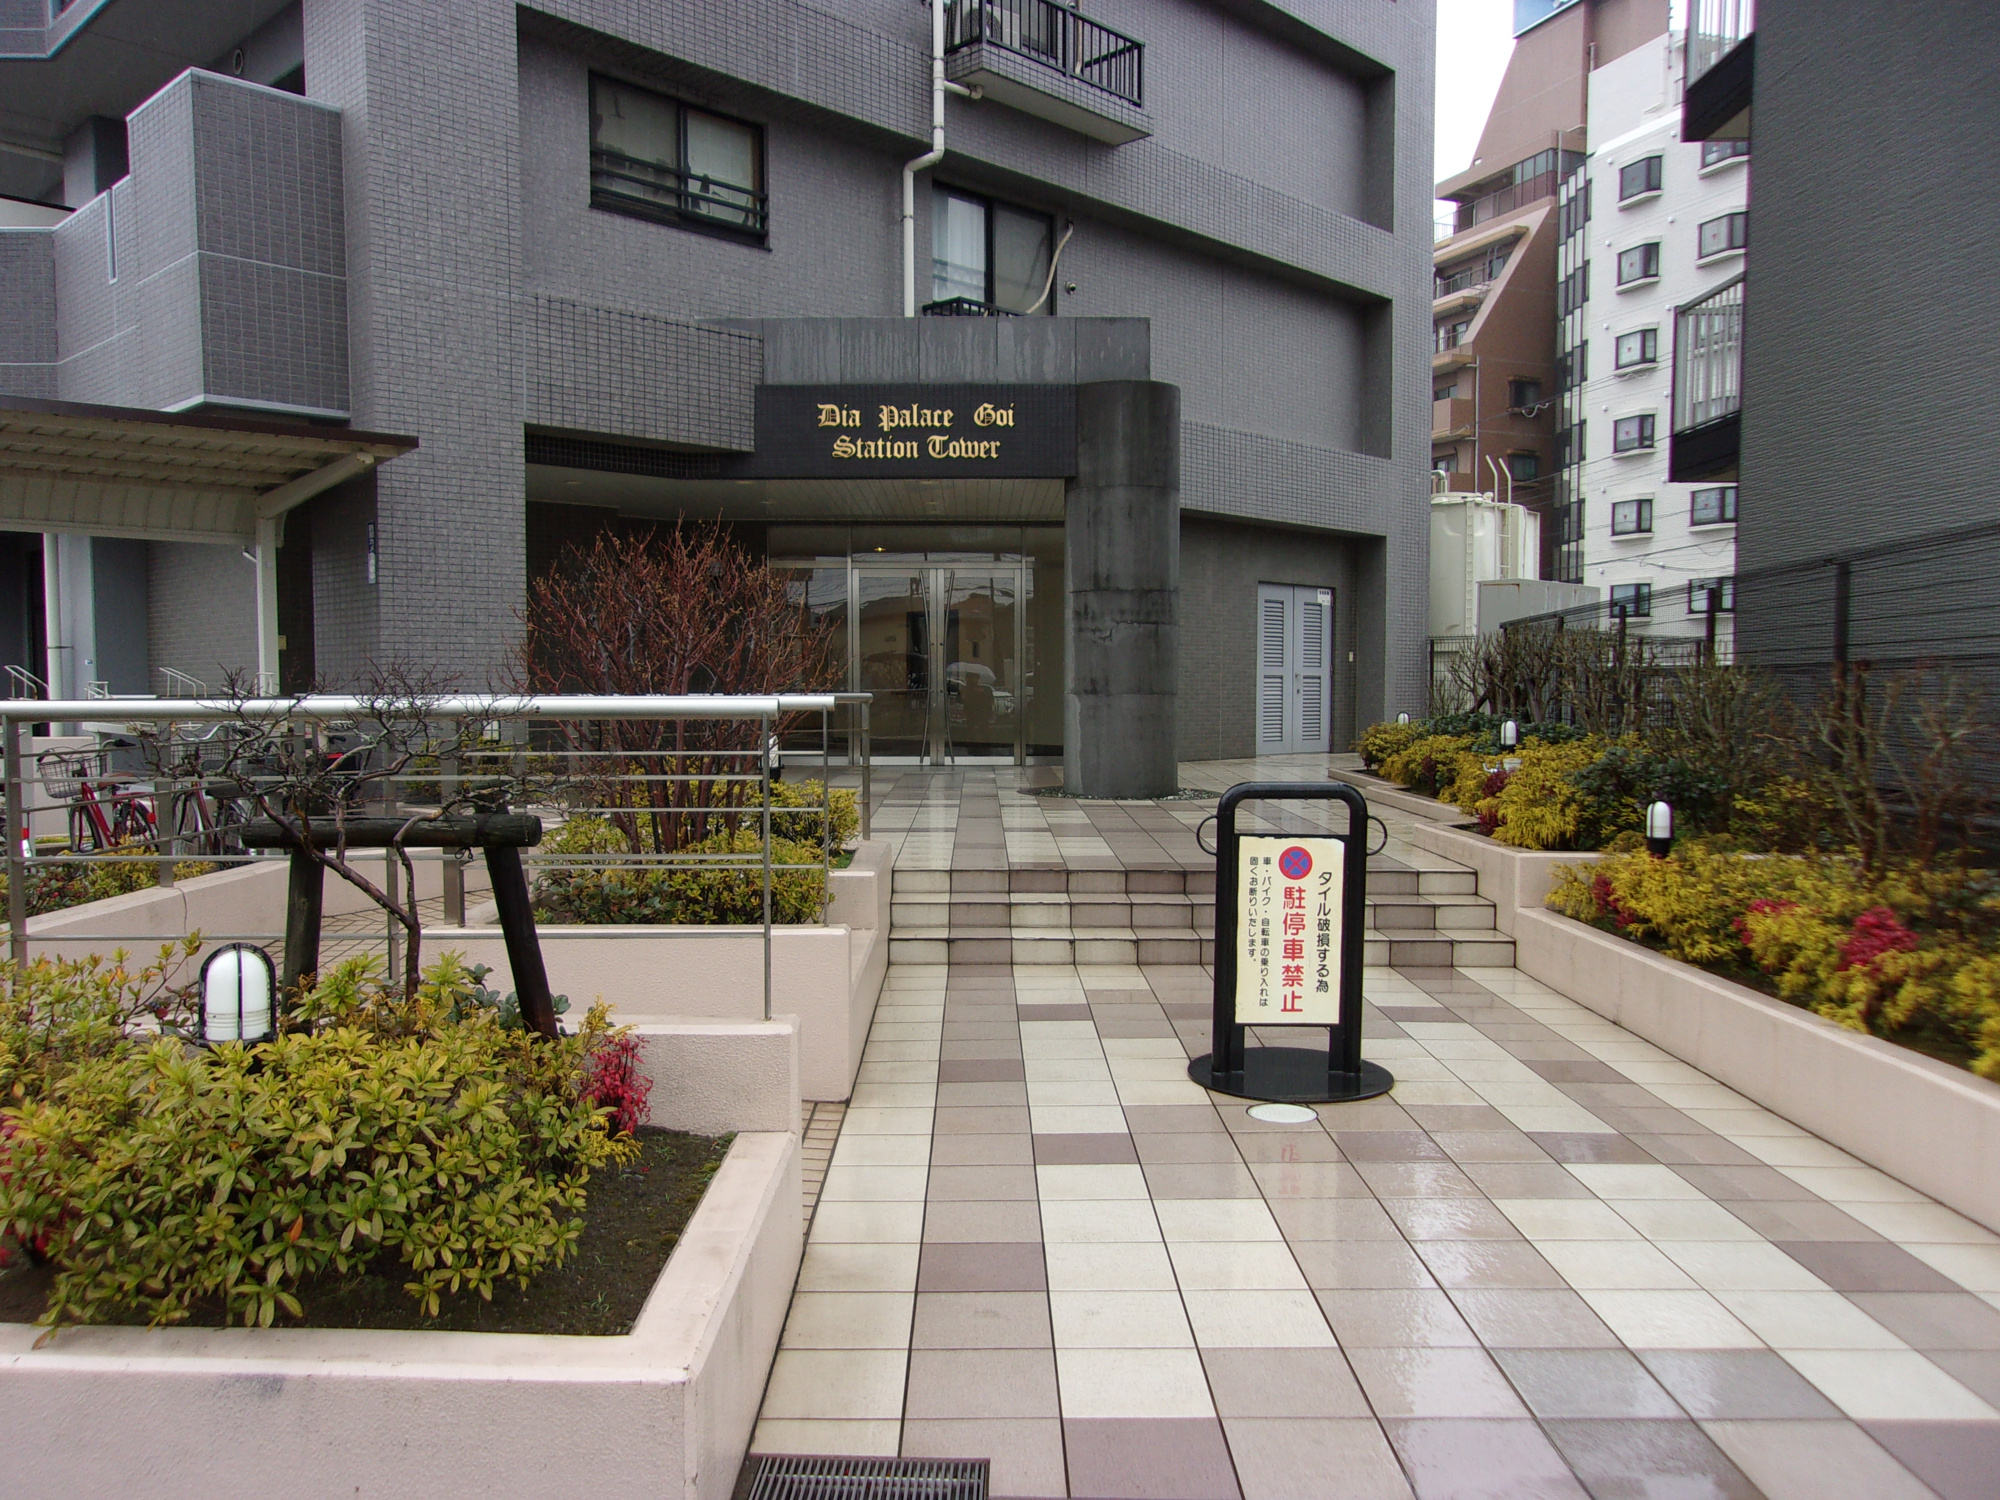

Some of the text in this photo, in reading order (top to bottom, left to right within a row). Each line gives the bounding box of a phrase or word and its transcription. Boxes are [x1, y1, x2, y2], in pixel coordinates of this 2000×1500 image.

[817, 403, 1015, 431] Dia Palace Goi
[832, 434, 1001, 459] Station Tower
[1281, 886, 1306, 1013] 駐停車禁止
[1316, 871, 1332, 993] タイル破損する為
